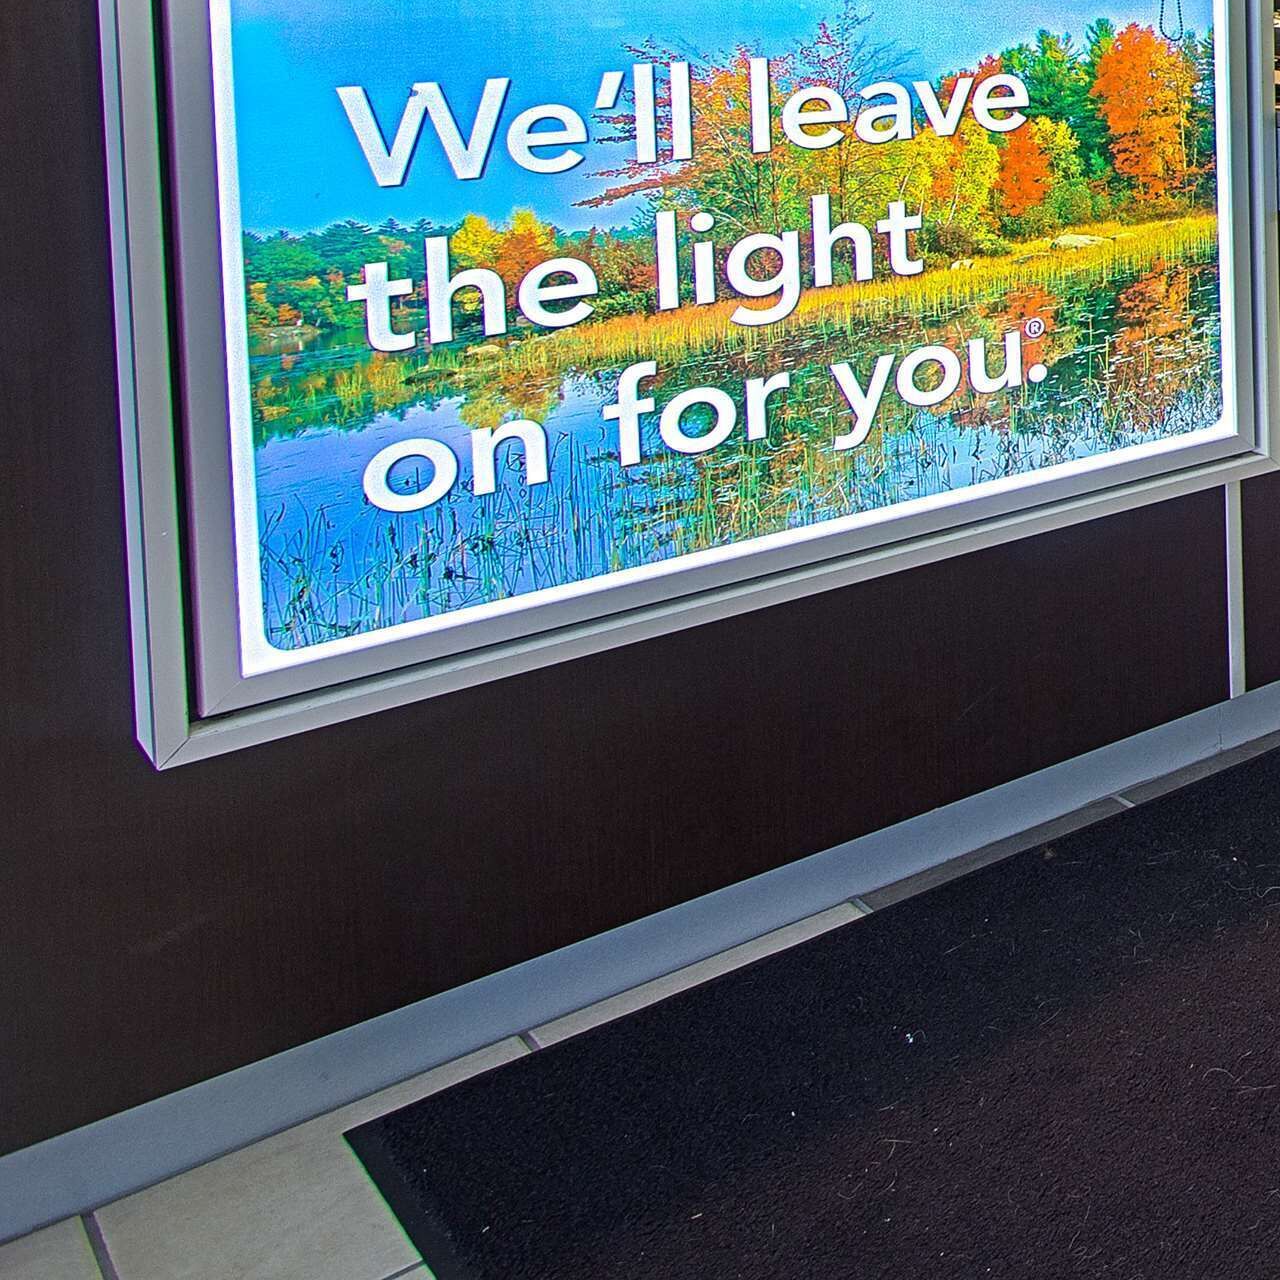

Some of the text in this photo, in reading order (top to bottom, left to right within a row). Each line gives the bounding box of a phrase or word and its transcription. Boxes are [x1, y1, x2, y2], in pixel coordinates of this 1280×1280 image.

[336, 57, 1030, 188] We'll leave
[347, 194, 924, 354] the light
[362, 419, 549, 513] on
[603, 360, 790, 467] for
